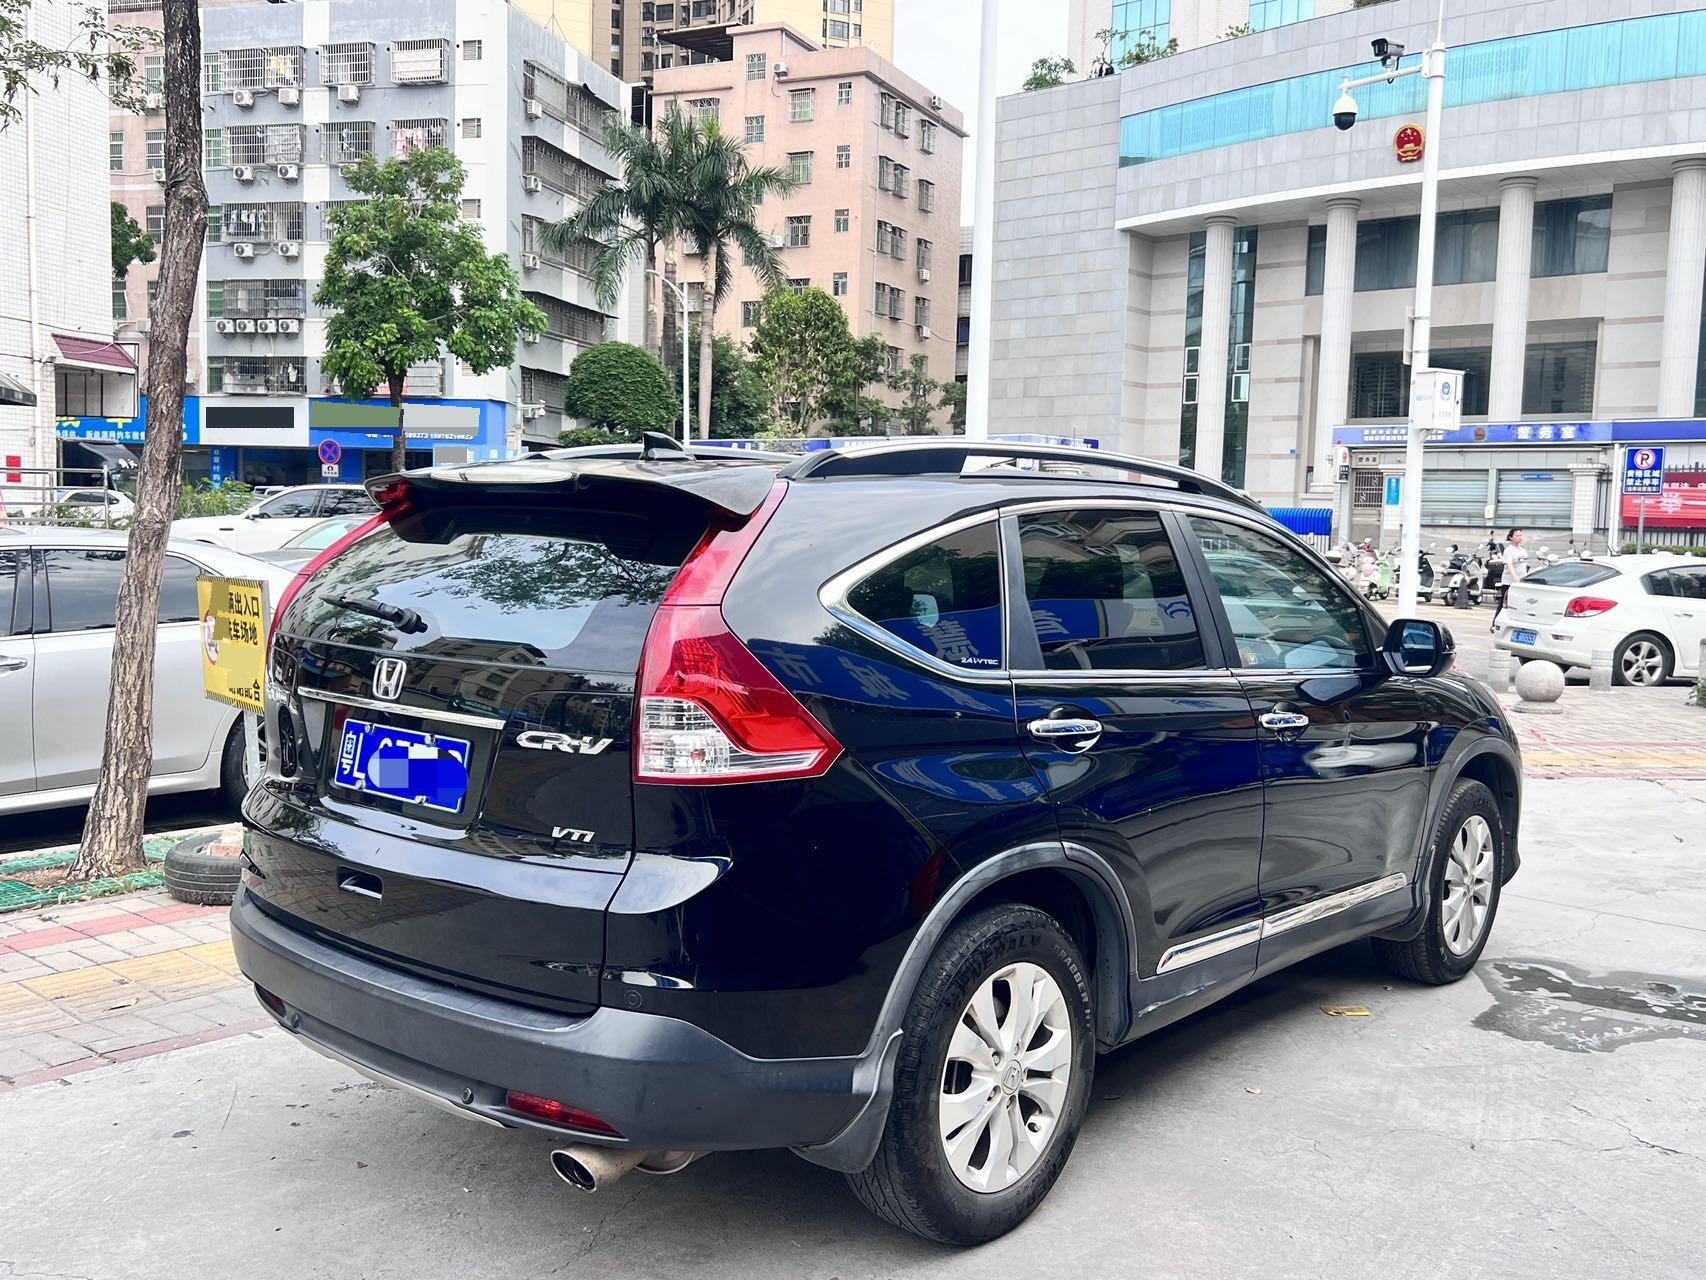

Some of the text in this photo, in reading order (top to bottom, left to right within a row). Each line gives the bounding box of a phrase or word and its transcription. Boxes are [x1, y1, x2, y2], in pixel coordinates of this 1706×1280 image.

[1517, 425, 1576, 440] 警务室
[1626, 478, 1660, 486] 禁止停车
